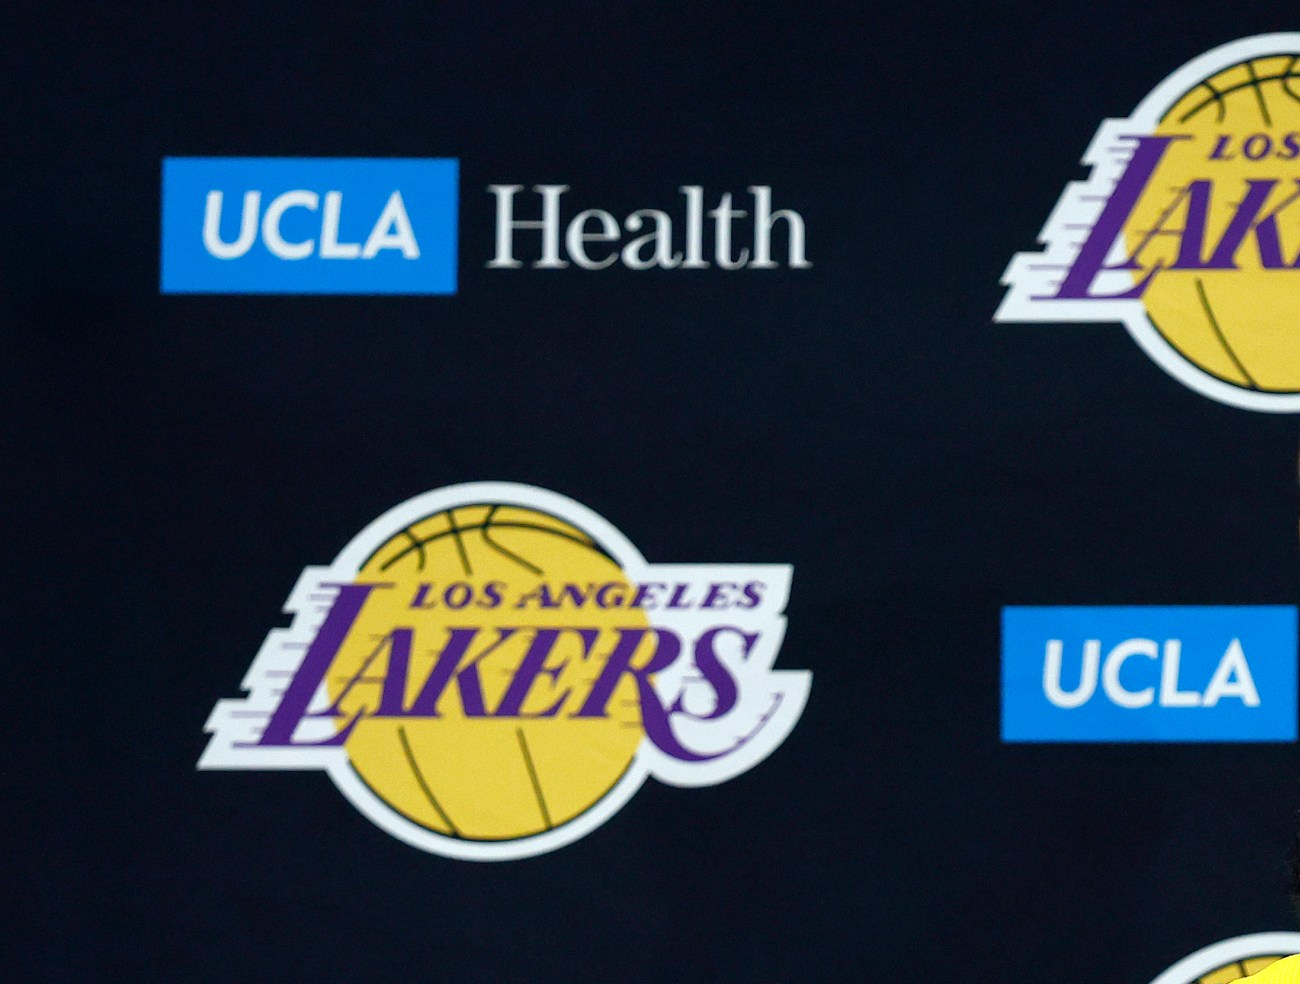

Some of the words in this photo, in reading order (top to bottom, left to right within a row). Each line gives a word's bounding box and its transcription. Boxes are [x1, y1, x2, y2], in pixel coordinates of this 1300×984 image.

[201, 190, 421, 261] UCLA
[487, 184, 812, 270] Health
[410, 582, 502, 609] LOS
[516, 580, 767, 609] ANGELES
[232, 581, 783, 762] LAKERS
[1042, 637, 1262, 709] UCLA
